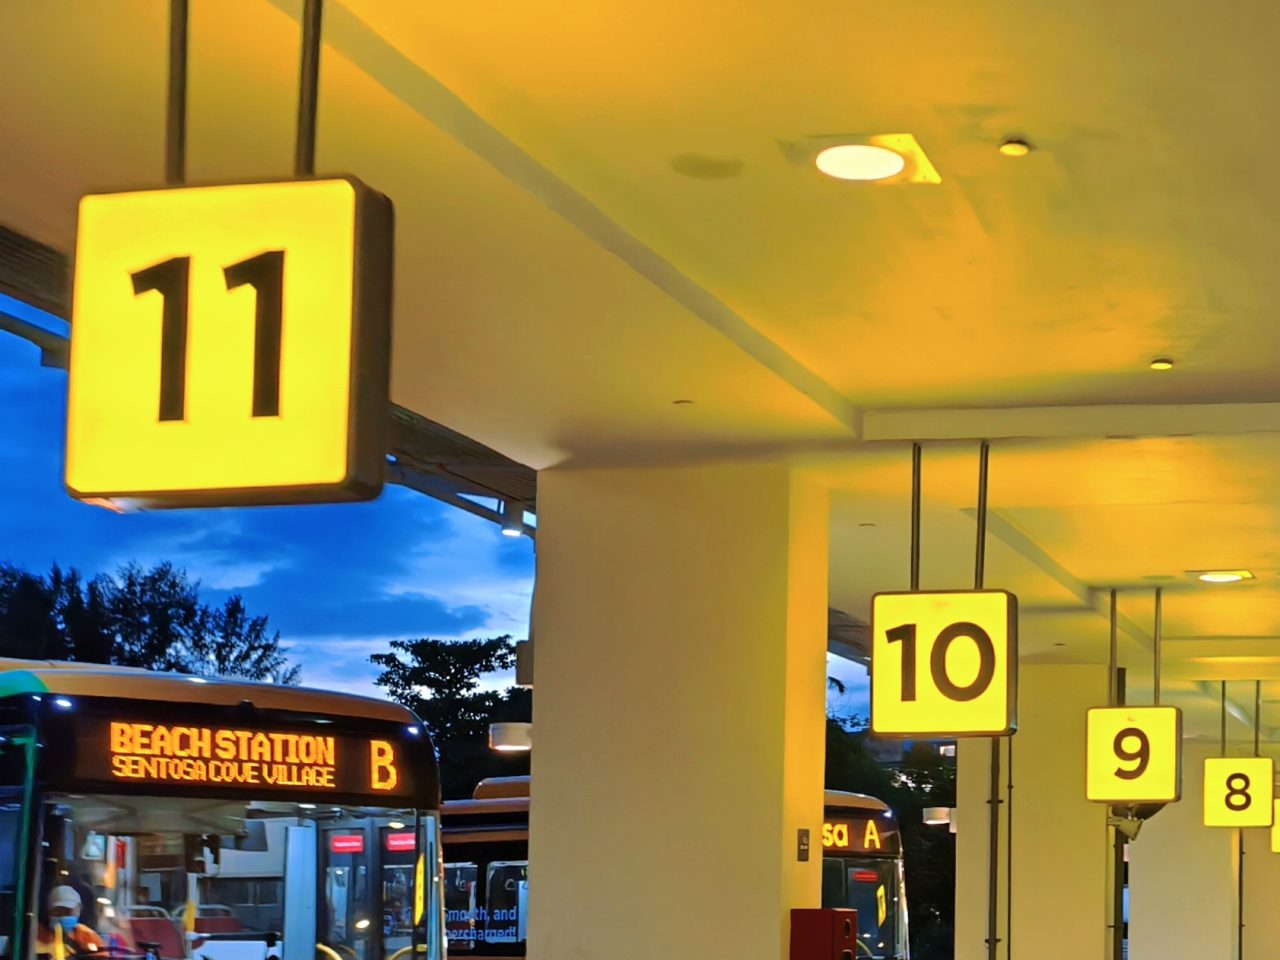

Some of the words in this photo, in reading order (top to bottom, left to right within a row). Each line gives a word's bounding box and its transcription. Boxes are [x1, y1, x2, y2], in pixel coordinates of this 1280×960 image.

[130, 249, 286, 423] 11
[885, 621, 996, 702] 10
[110, 722, 211, 757] BEACH
[215, 729, 335, 765] STATION
[370, 740, 398, 790] B
[1112, 727, 1151, 780] 9
[112, 755, 207, 781] SENTOSA
[208, 761, 260, 783] COVE
[262, 765, 335, 788] VILLAGE
[1224, 772, 1252, 811] 8
[864, 819, 881, 849] A
[493, 906, 517, 921] and
